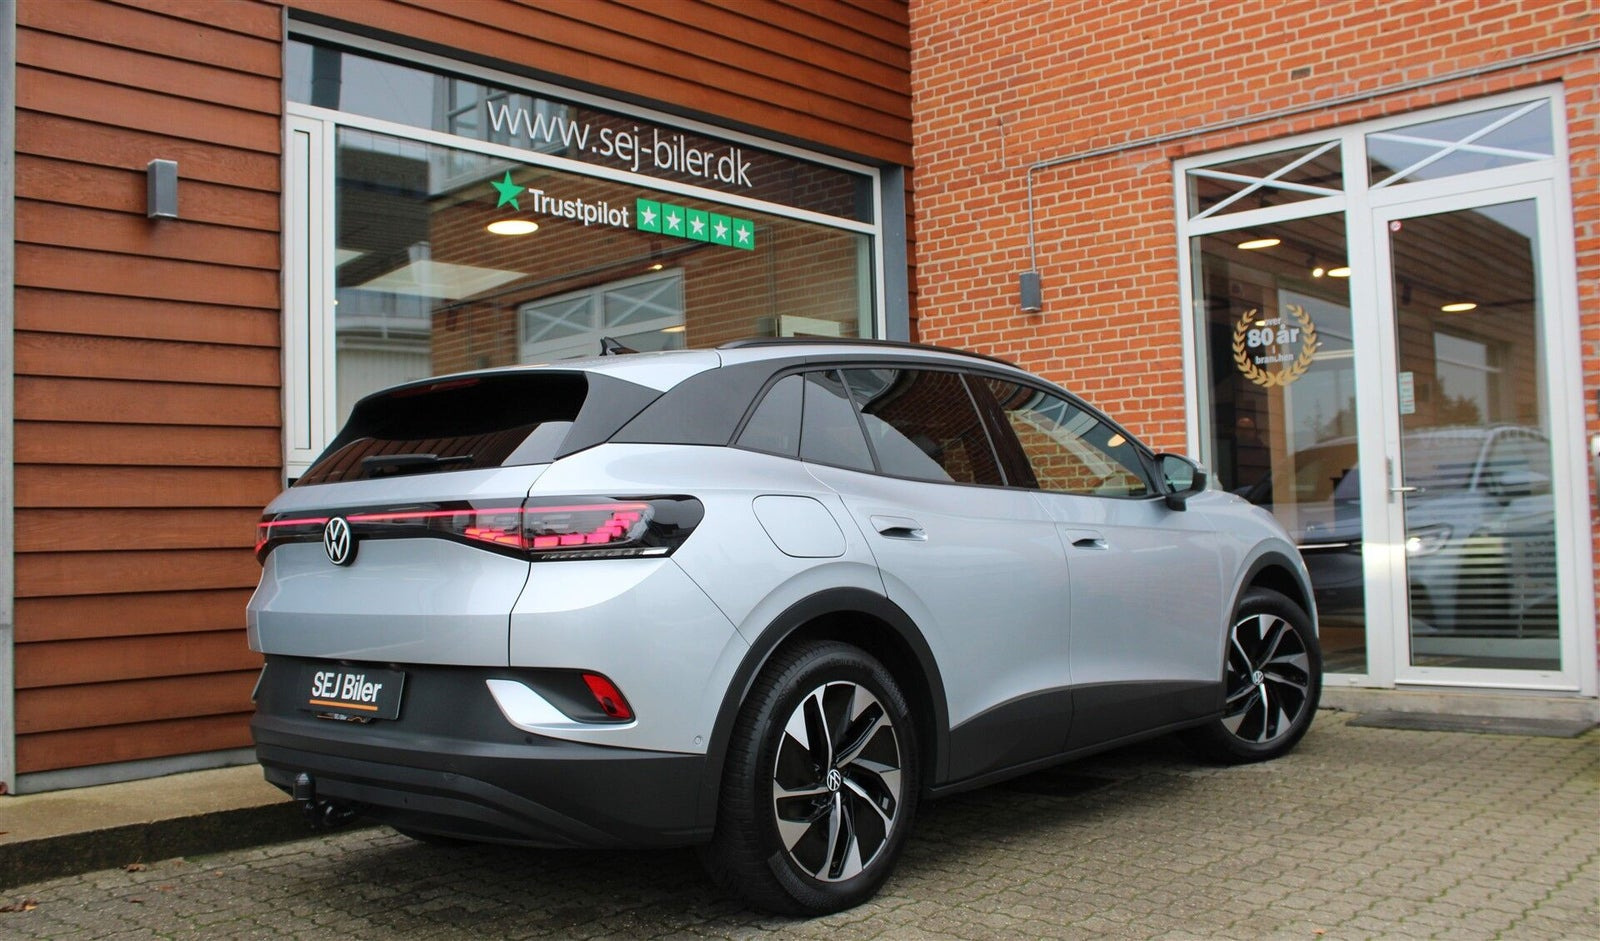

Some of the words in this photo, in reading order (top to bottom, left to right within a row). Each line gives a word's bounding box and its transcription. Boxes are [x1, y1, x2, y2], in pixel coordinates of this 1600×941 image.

[487, 101, 753, 187] www.sej-biler.dk
[528, 188, 630, 228] Trustpilot
[1247, 328, 1274, 347] 80
[1276, 324, 1299, 344] år
[311, 671, 342, 698] SEJ
[341, 673, 382, 702] Biler
